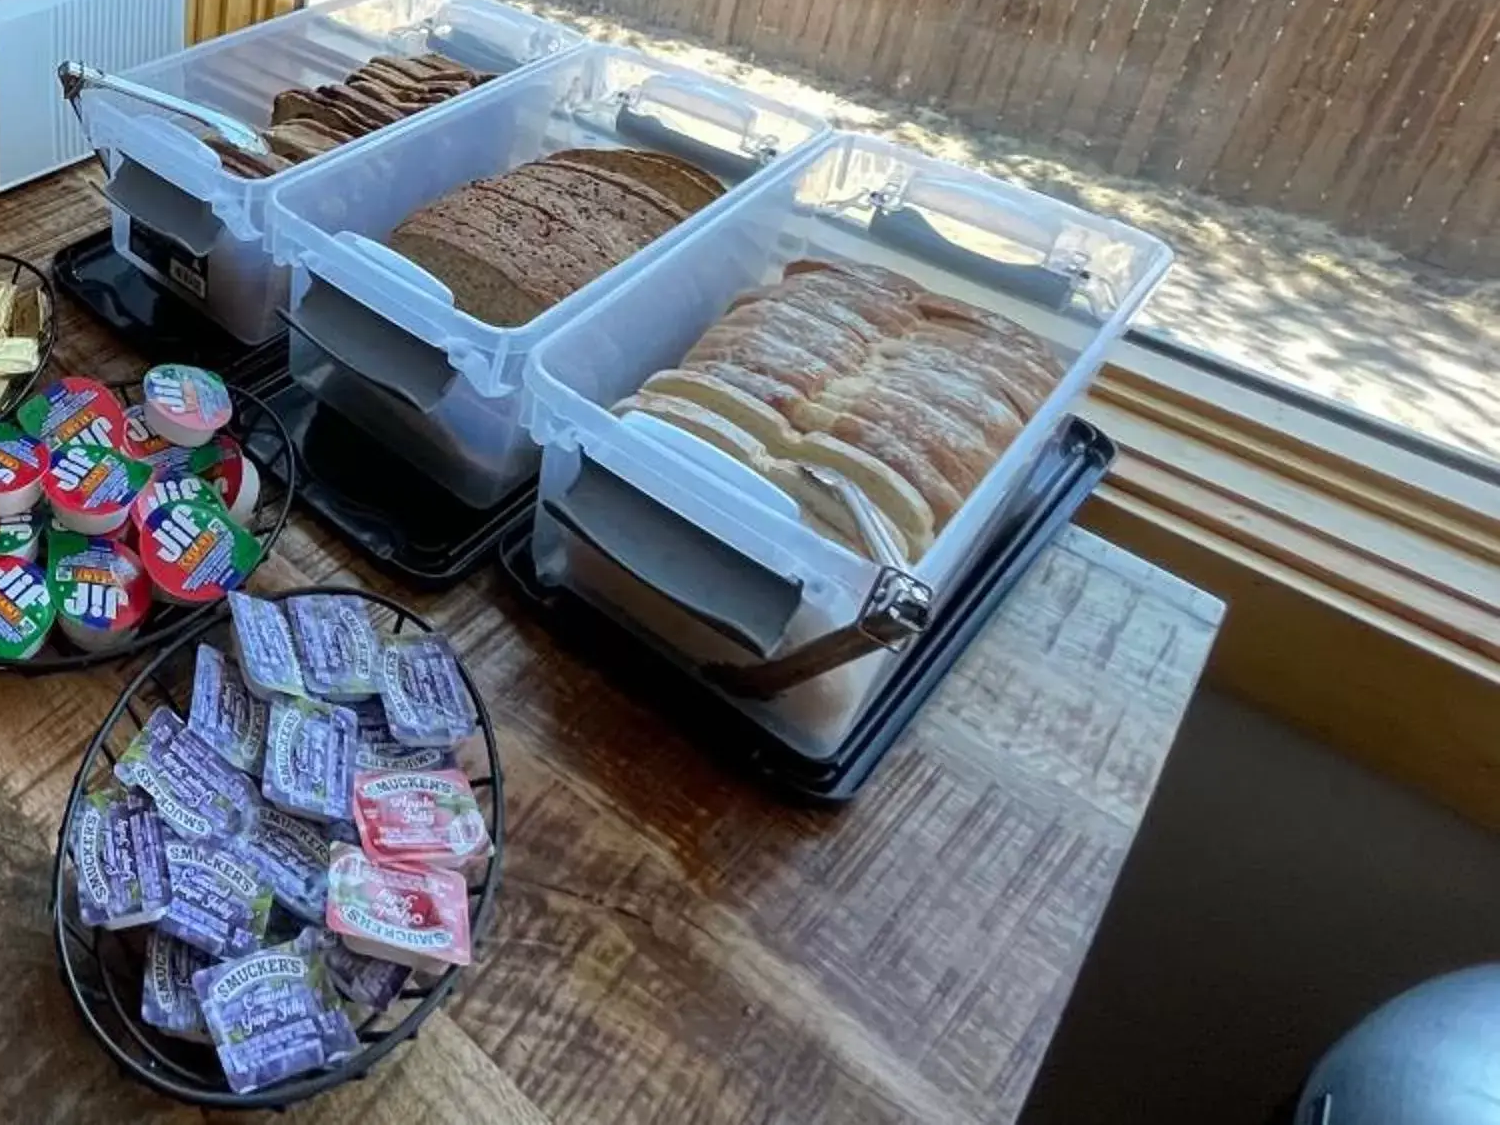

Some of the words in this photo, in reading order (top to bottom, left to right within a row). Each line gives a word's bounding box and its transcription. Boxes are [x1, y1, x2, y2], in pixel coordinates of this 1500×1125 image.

[50, 446, 96, 492] Jif
[151, 503, 202, 564] Jif
[63, 581, 129, 620] Jif
